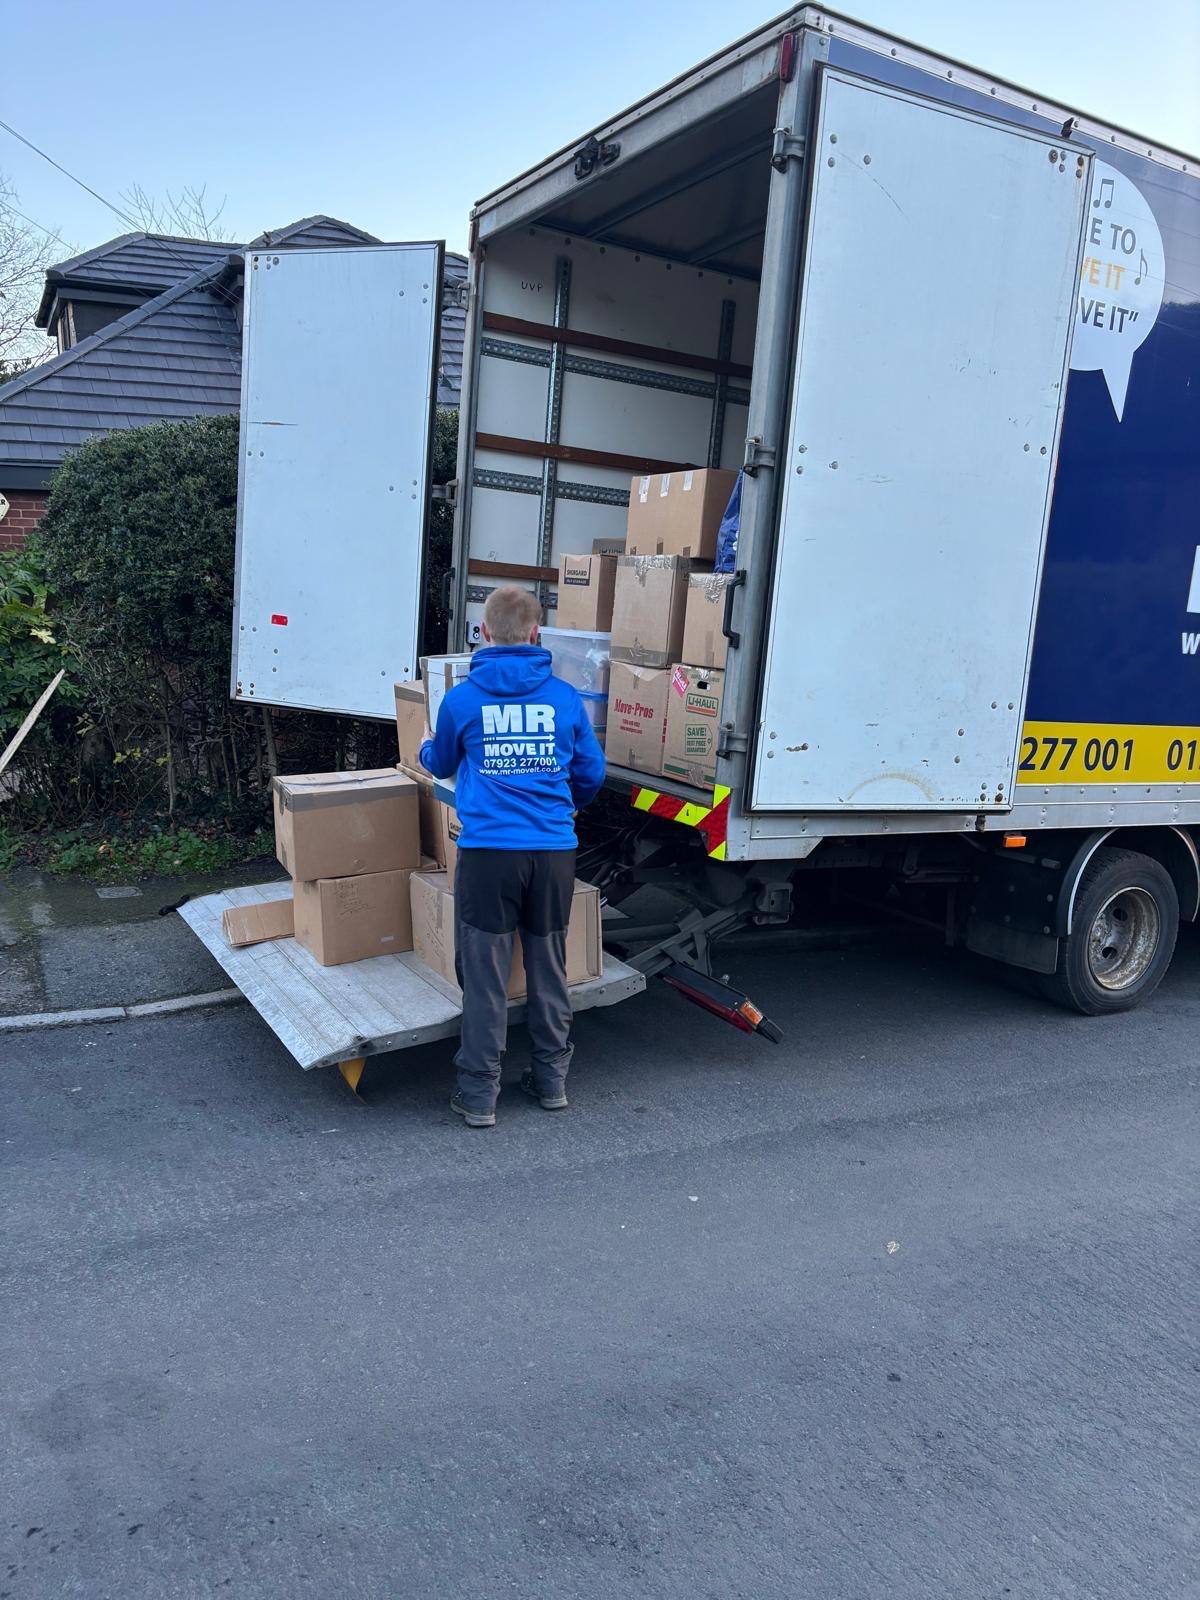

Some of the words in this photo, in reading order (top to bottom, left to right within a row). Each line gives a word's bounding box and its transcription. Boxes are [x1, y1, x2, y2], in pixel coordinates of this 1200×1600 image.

[1110, 223, 1137, 255] TO
[1105, 263, 1127, 290] IT
[481, 704, 556, 734] MR
[613, 698, 655, 719] Move-Pros
[687, 727, 707, 737] SAVE!
[484, 743, 537, 757] MOVE
[539, 742, 556, 756] IT
[1019, 736, 1078, 771] 277
[1084, 738, 1134, 771] 001
[1167, 739, 1200, 771] 01
[478, 765, 562, 776] www.mr-moveit.co.uk
[483, 758, 517, 769] 07923
[519, 756, 558, 767] 277001
